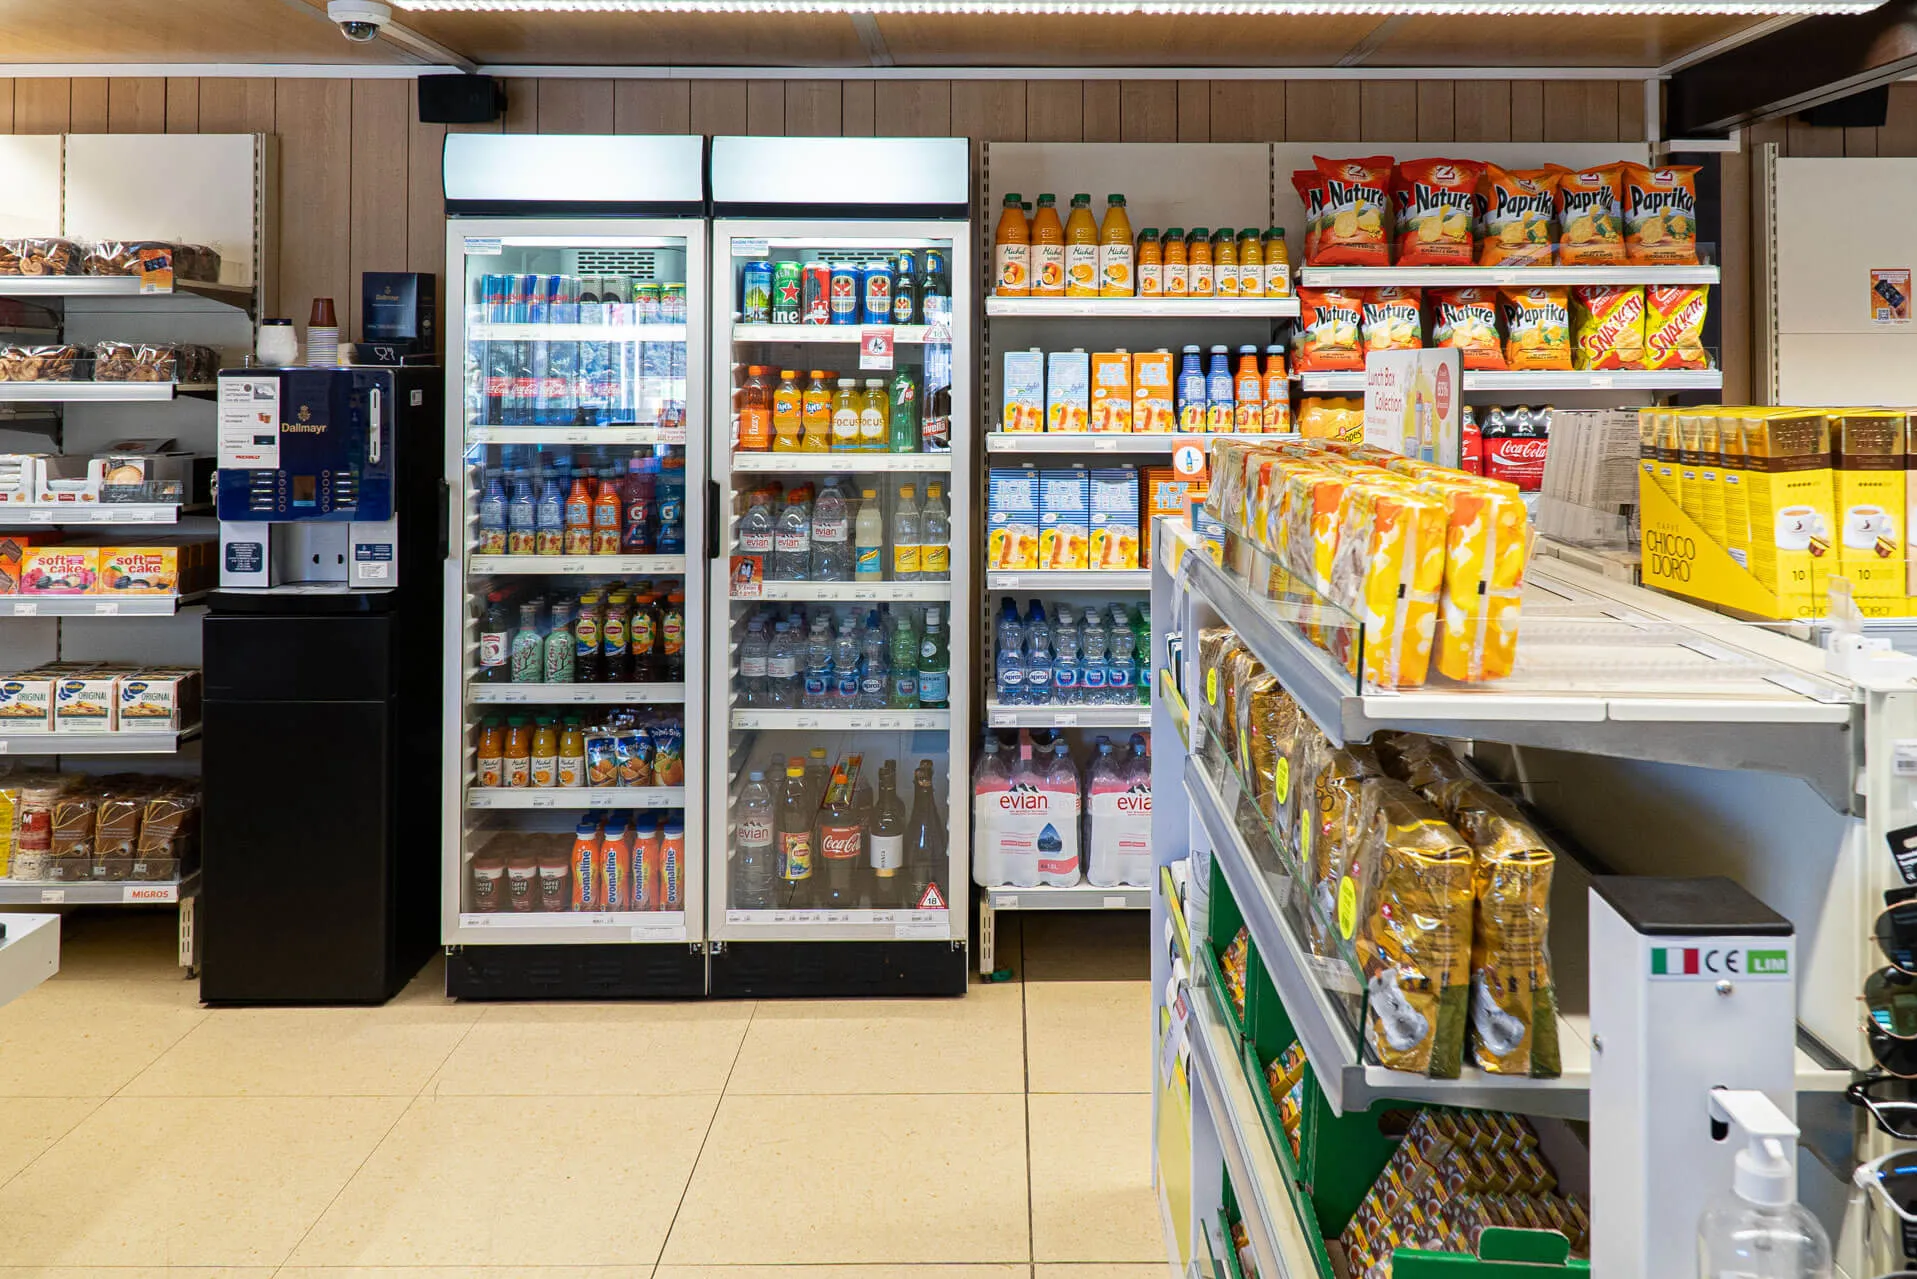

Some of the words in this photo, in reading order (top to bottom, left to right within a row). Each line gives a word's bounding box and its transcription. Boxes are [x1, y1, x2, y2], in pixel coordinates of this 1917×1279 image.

[1328, 180, 1385, 210] Nature
[1415, 183, 1472, 213] Nature
[1496, 185, 1552, 217] Paprik
[1004, 246, 1026, 255] Michel
[1043, 246, 1064, 255] Michel
[1072, 246, 1094, 255] Michel
[1107, 246, 1129, 255] Michel
[1315, 306, 1357, 328] Nature
[1364, 303, 1416, 325] Nature
[1442, 304, 1494, 324] Nature
[1516, 305, 1565, 327] Paprika
[1368, 368, 1384, 386] Lunch
[1385, 367, 1395, 386] Box
[776, 402, 793, 412] FANTA
[1375, 391, 1402, 413] Collection
[282, 422, 327, 435] Dallmayr
[922, 420, 946, 437] rivella
[1500, 440, 1549, 458] Coca-Cola
[1158, 482, 1188, 496] ICE
[630, 506, 643, 519] G
[662, 505, 674, 518] G
[815, 527, 837, 536] evian
[746, 538, 769, 547] evian
[777, 538, 800, 547] evian
[1646, 530, 1695, 560] CHICCO
[38, 555, 66, 565] soft
[116, 555, 144, 565] soft
[50, 564, 82, 574] cake
[129, 564, 161, 574] cake
[1792, 570, 1806, 581] 10
[1858, 569, 1871, 580] 10
[17, 693, 47, 702] ORIGINAL
[78, 692, 107, 701] ORIGINAL
[142, 693, 171, 702] ORIGINAL
[1000, 793, 1048, 809] evian
[1117, 793, 1152, 810] evia
[23, 814, 33, 824] M
[738, 827, 769, 839] evian
[582, 850, 591, 902] ovomaltine
[608, 850, 616, 904] ovomaltine
[635, 848, 643, 900] ovomaltine
[667, 849, 675, 901] ovomaltine
[132, 890, 169, 898] MIGROS
